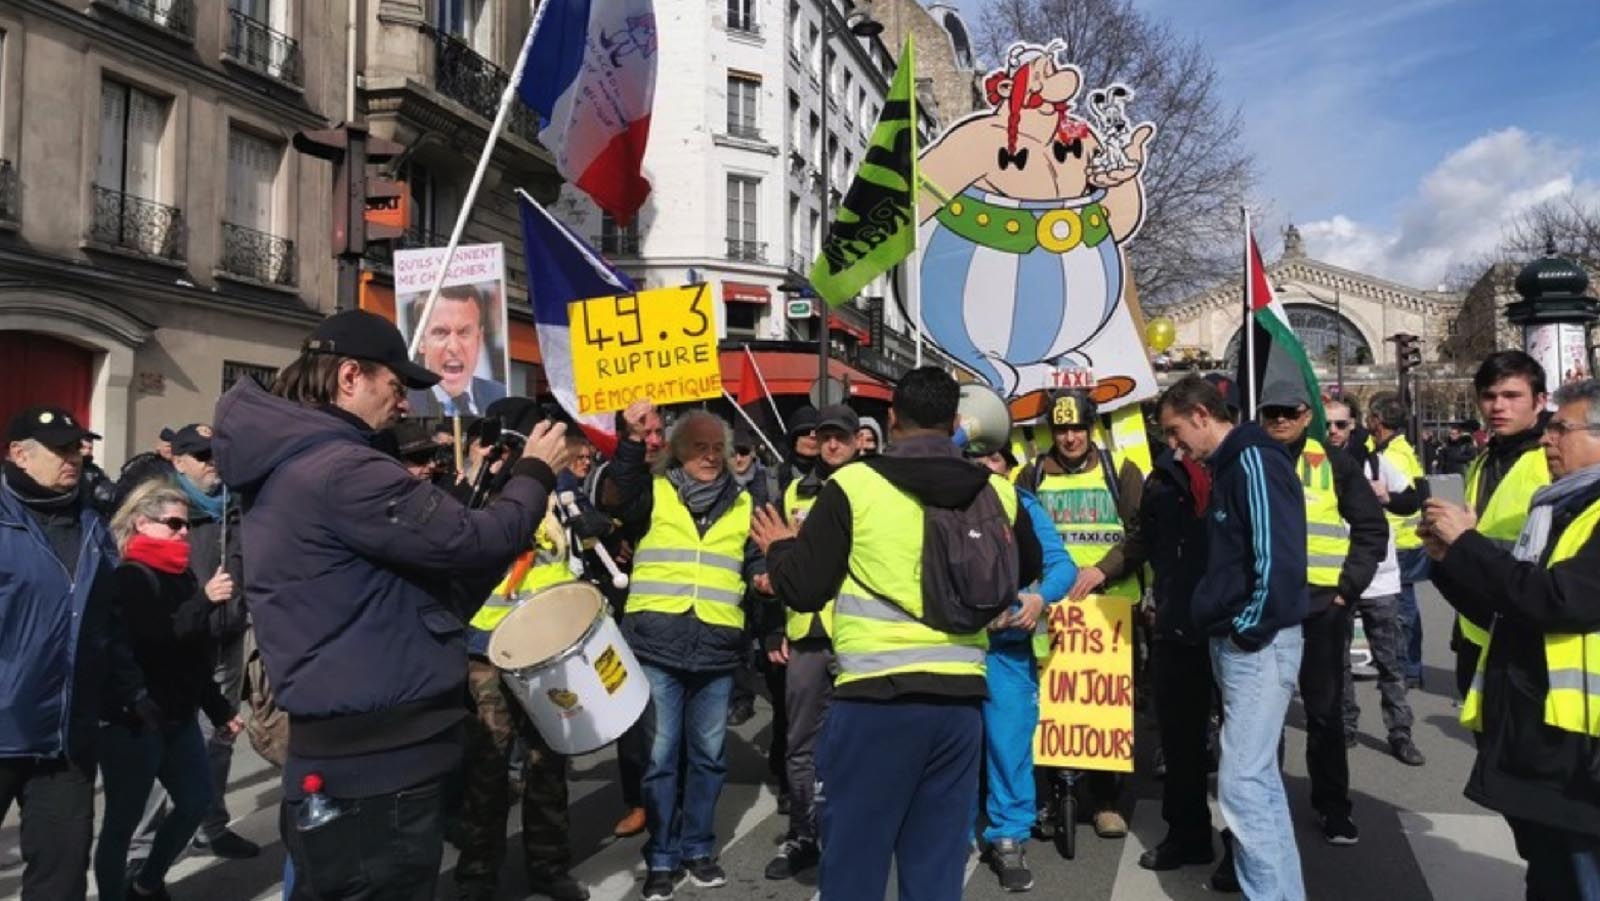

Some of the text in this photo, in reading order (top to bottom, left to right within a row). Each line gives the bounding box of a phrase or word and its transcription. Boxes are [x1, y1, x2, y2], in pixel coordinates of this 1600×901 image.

[420, 264, 487, 285] CHRCHER
[596, 342, 710, 379] RUPTURE
[1051, 371, 1093, 387] TAXI
[1048, 619, 1124, 654] ATIS !
[1049, 668, 1078, 704] UN
[1038, 718, 1134, 761] TOUJOURS
